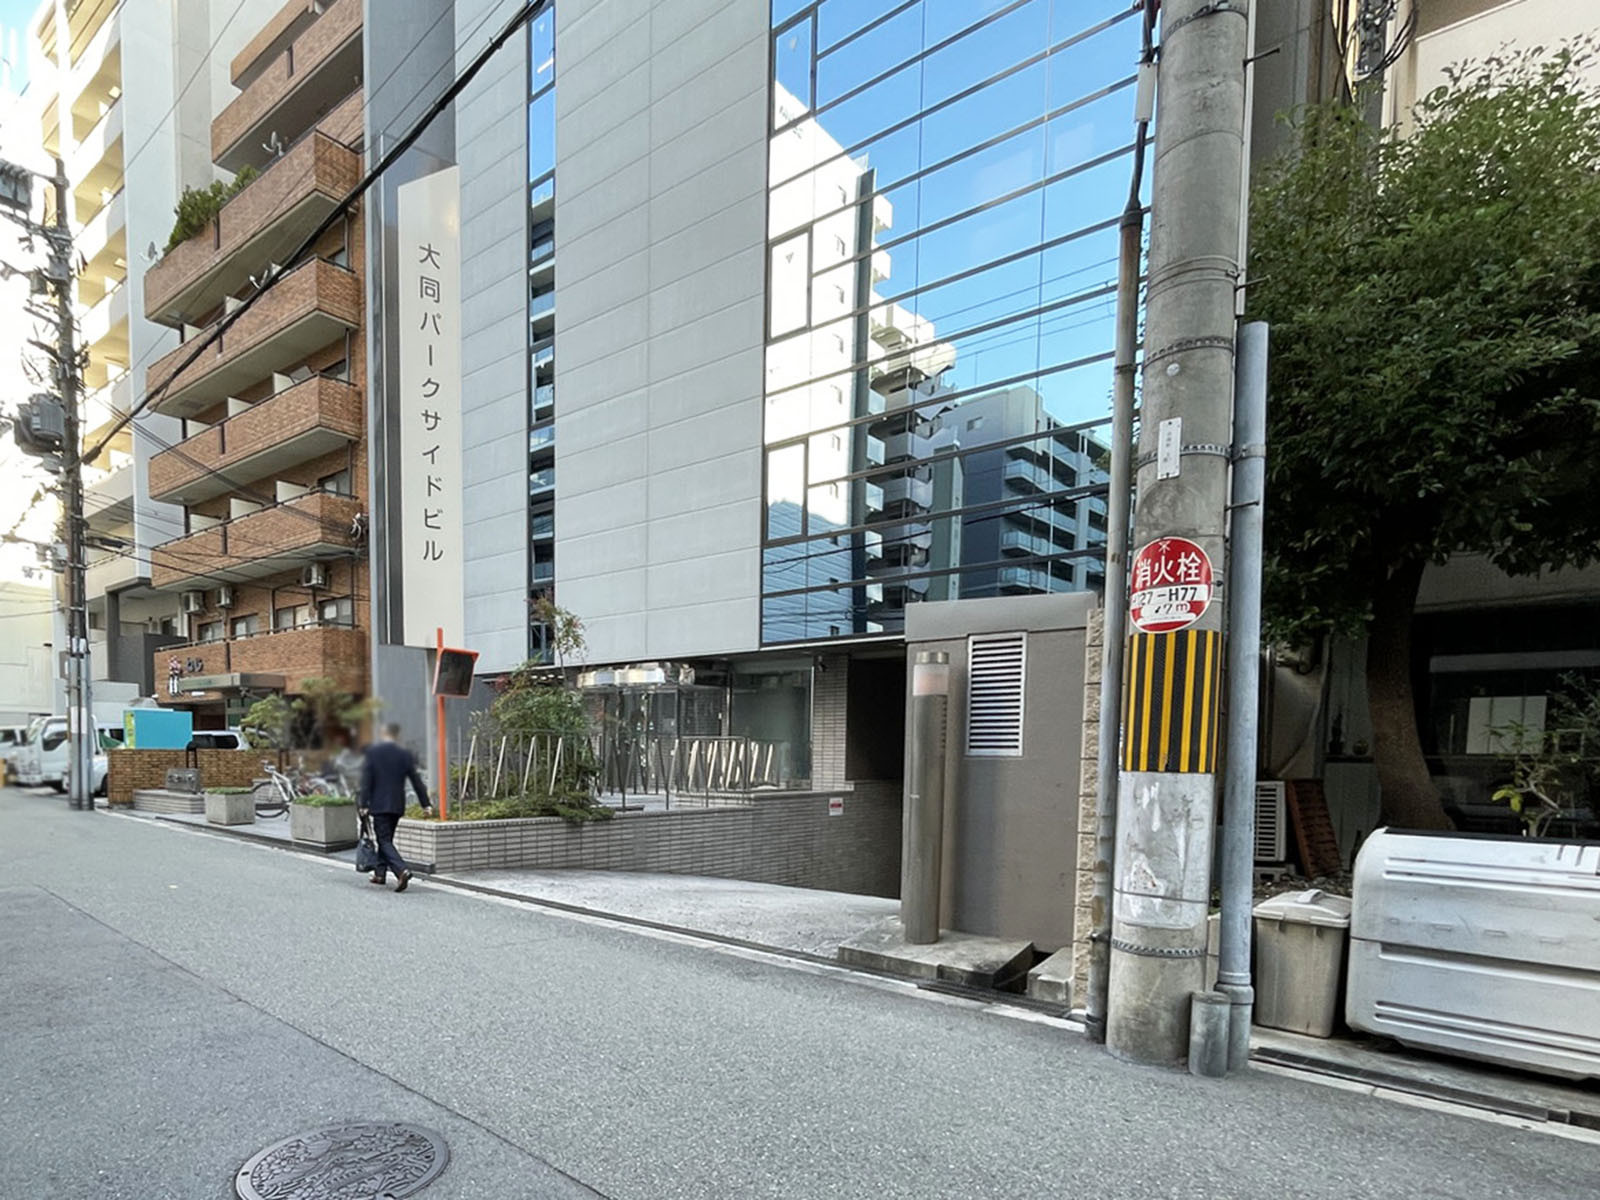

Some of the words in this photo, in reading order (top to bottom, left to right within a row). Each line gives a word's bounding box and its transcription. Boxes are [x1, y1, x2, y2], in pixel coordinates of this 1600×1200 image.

[418, 242, 443, 562] 大同パークサイドビル
[1135, 551, 1202, 588] 消火栓
